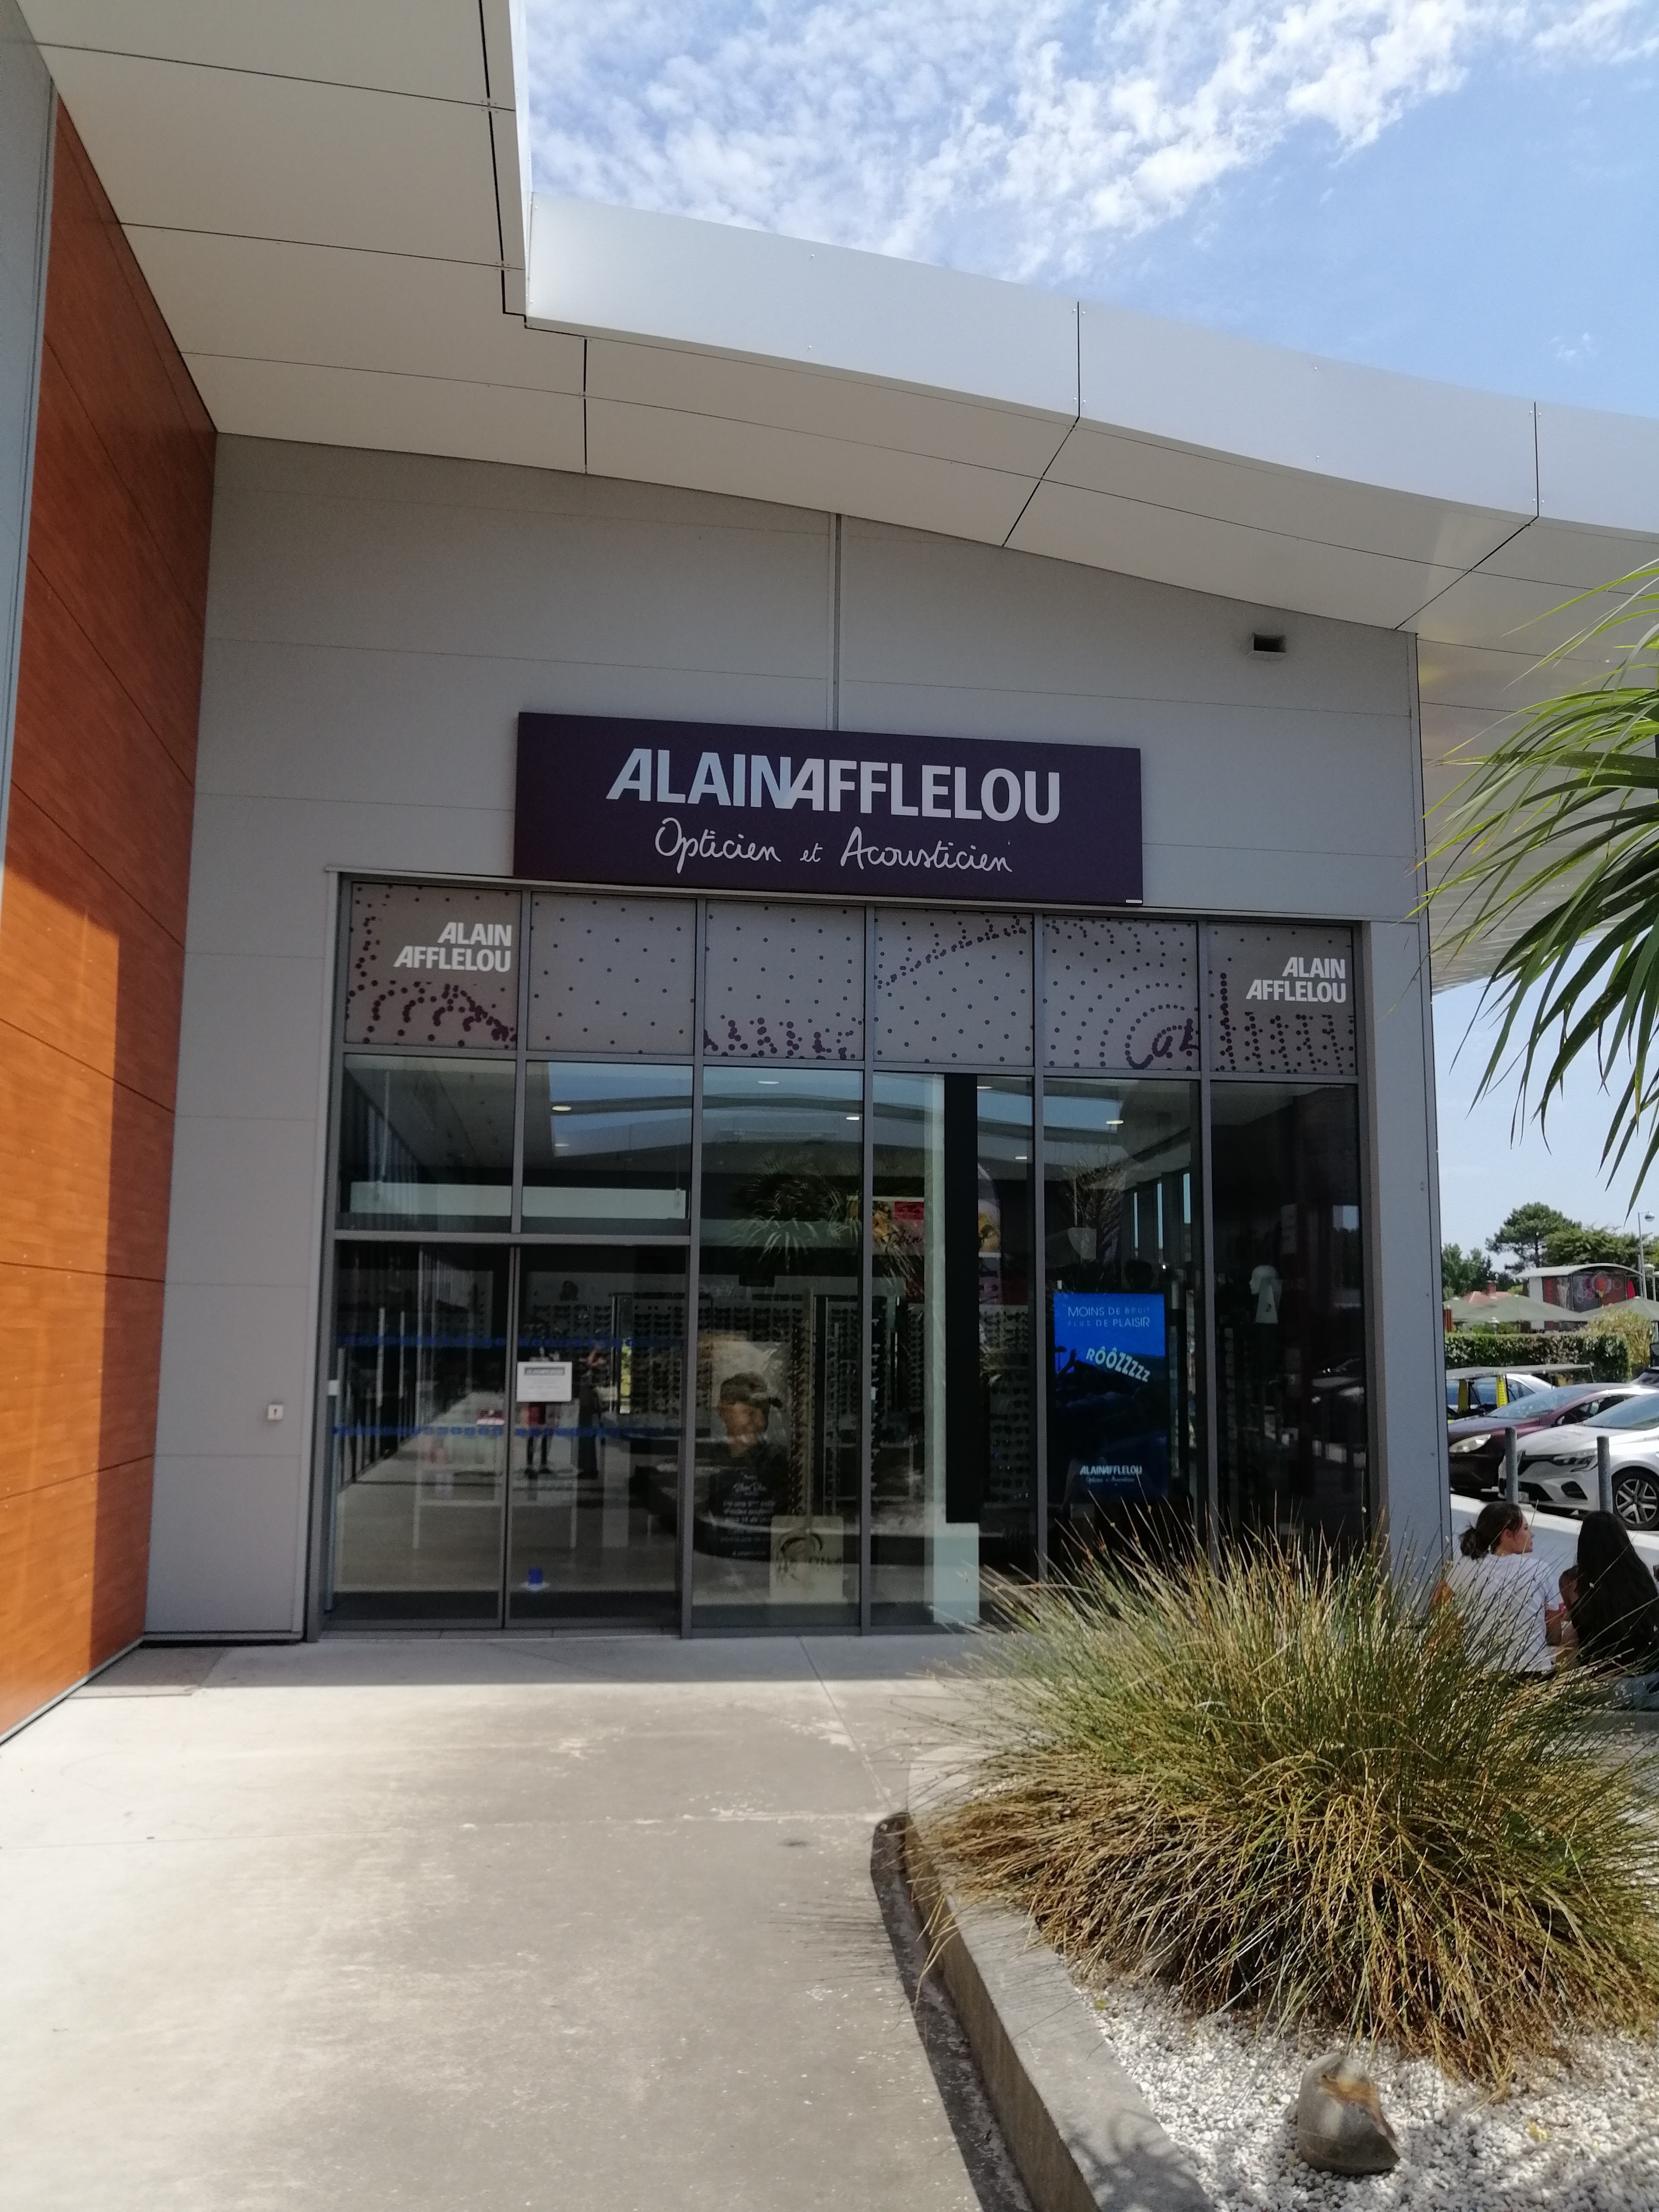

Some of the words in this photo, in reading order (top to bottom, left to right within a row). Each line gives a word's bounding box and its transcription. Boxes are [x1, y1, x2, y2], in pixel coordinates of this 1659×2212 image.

[655, 817, 782, 874] Opticien
[800, 842, 823, 863] et
[840, 826, 1013, 873] Acousticien
[437, 922, 512, 947] ALAIN
[393, 946, 512, 973] AFFLELOU
[1281, 957, 1346, 979] ALAIN
[1245, 979, 1347, 1003] AFFLELOU
[1068, 1306, 1105, 1317] MOINS
[1108, 1306, 1121, 1315] DE
[1096, 1319, 1108, 1328] DE
[1112, 1316, 1150, 1328] PLAISIR
